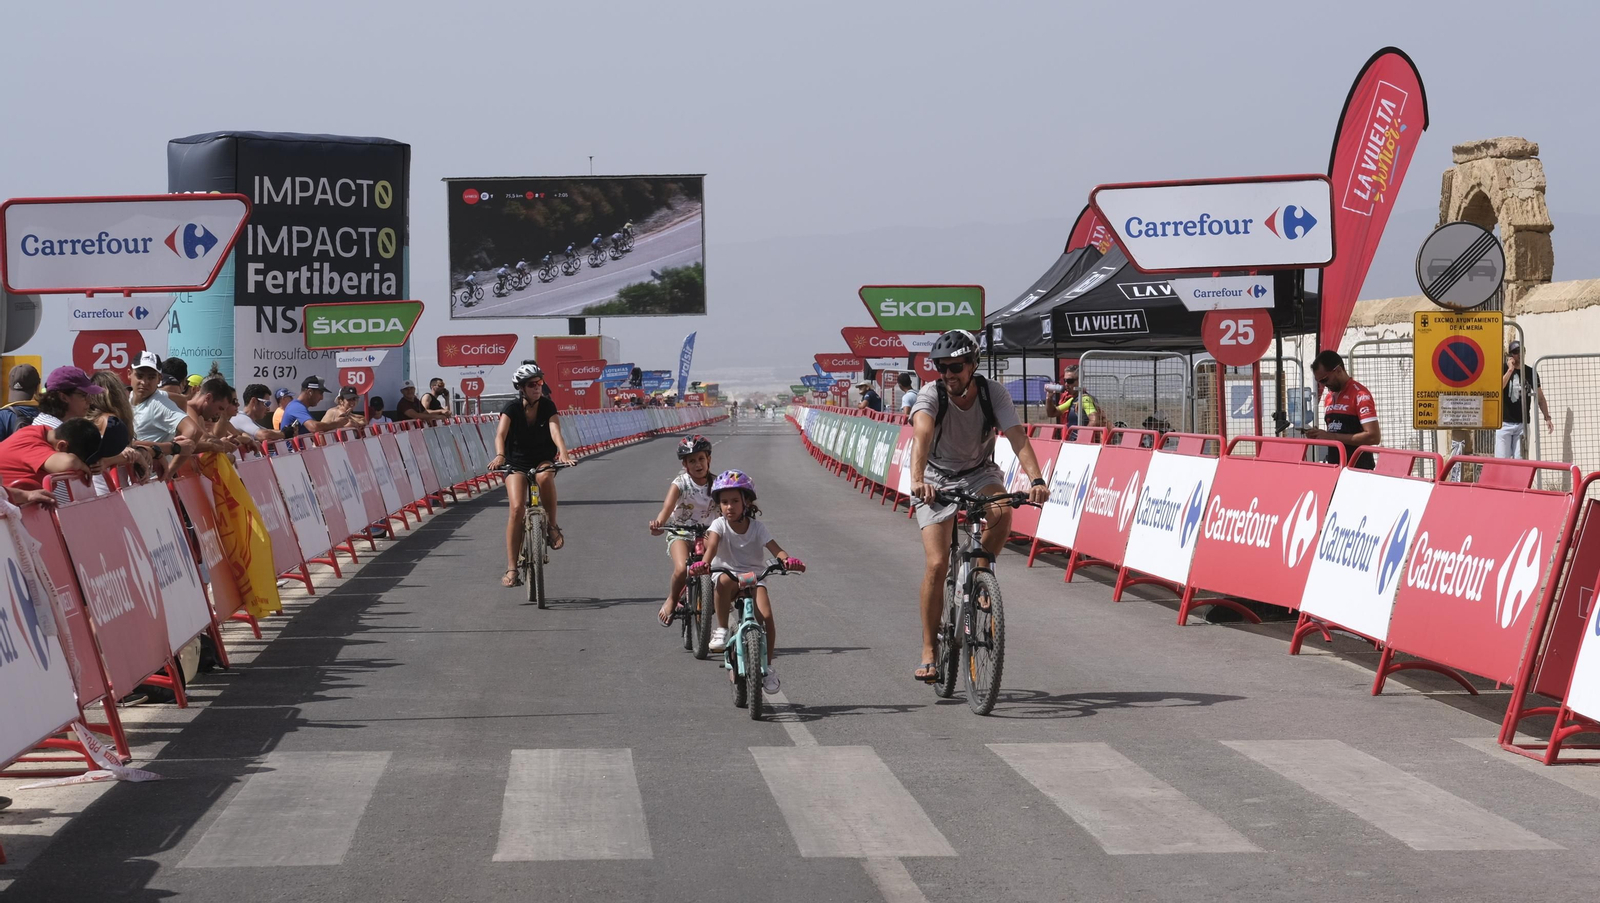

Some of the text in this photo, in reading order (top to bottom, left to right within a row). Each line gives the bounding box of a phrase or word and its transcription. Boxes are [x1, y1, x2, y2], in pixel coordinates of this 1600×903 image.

[1361, 98, 1397, 172] VUELTA
[1124, 212, 1254, 239] Carrefour
[21, 231, 153, 257] Carrefour
[247, 262, 397, 295] Fertiberia
[1132, 285, 1158, 297] LA
[1193, 287, 1243, 299] Carrefour
[73, 308, 124, 319] Carrefour
[880, 298, 975, 317] ŠKODA
[256, 305, 303, 334] NS
[312, 316, 405, 335] ŠKODA
[1075, 313, 1141, 332] LA VUELTA
[1219, 319, 1255, 345] 25
[92, 342, 129, 370] 25
[180, 346, 223, 358] Amónico
[253, 347, 319, 360] Nitrosulfato
[461, 343, 506, 355] Cofidis
[950, 346, 972, 358] BELL
[571, 365, 600, 374] Cofidis
[832, 358, 860, 366] Cofidis
[253, 365, 298, 380] 26 (37)
[347, 371, 366, 385] 50
[466, 381, 479, 391] 75
[1085, 476, 1121, 518] Carrefour
[1136, 485, 1182, 532] Carrefour
[1204, 494, 1279, 549] Carrefour
[1318, 511, 1380, 573] Carrefour
[1407, 531, 1495, 602] Carrefour
[79, 552, 135, 627] Carrefour
